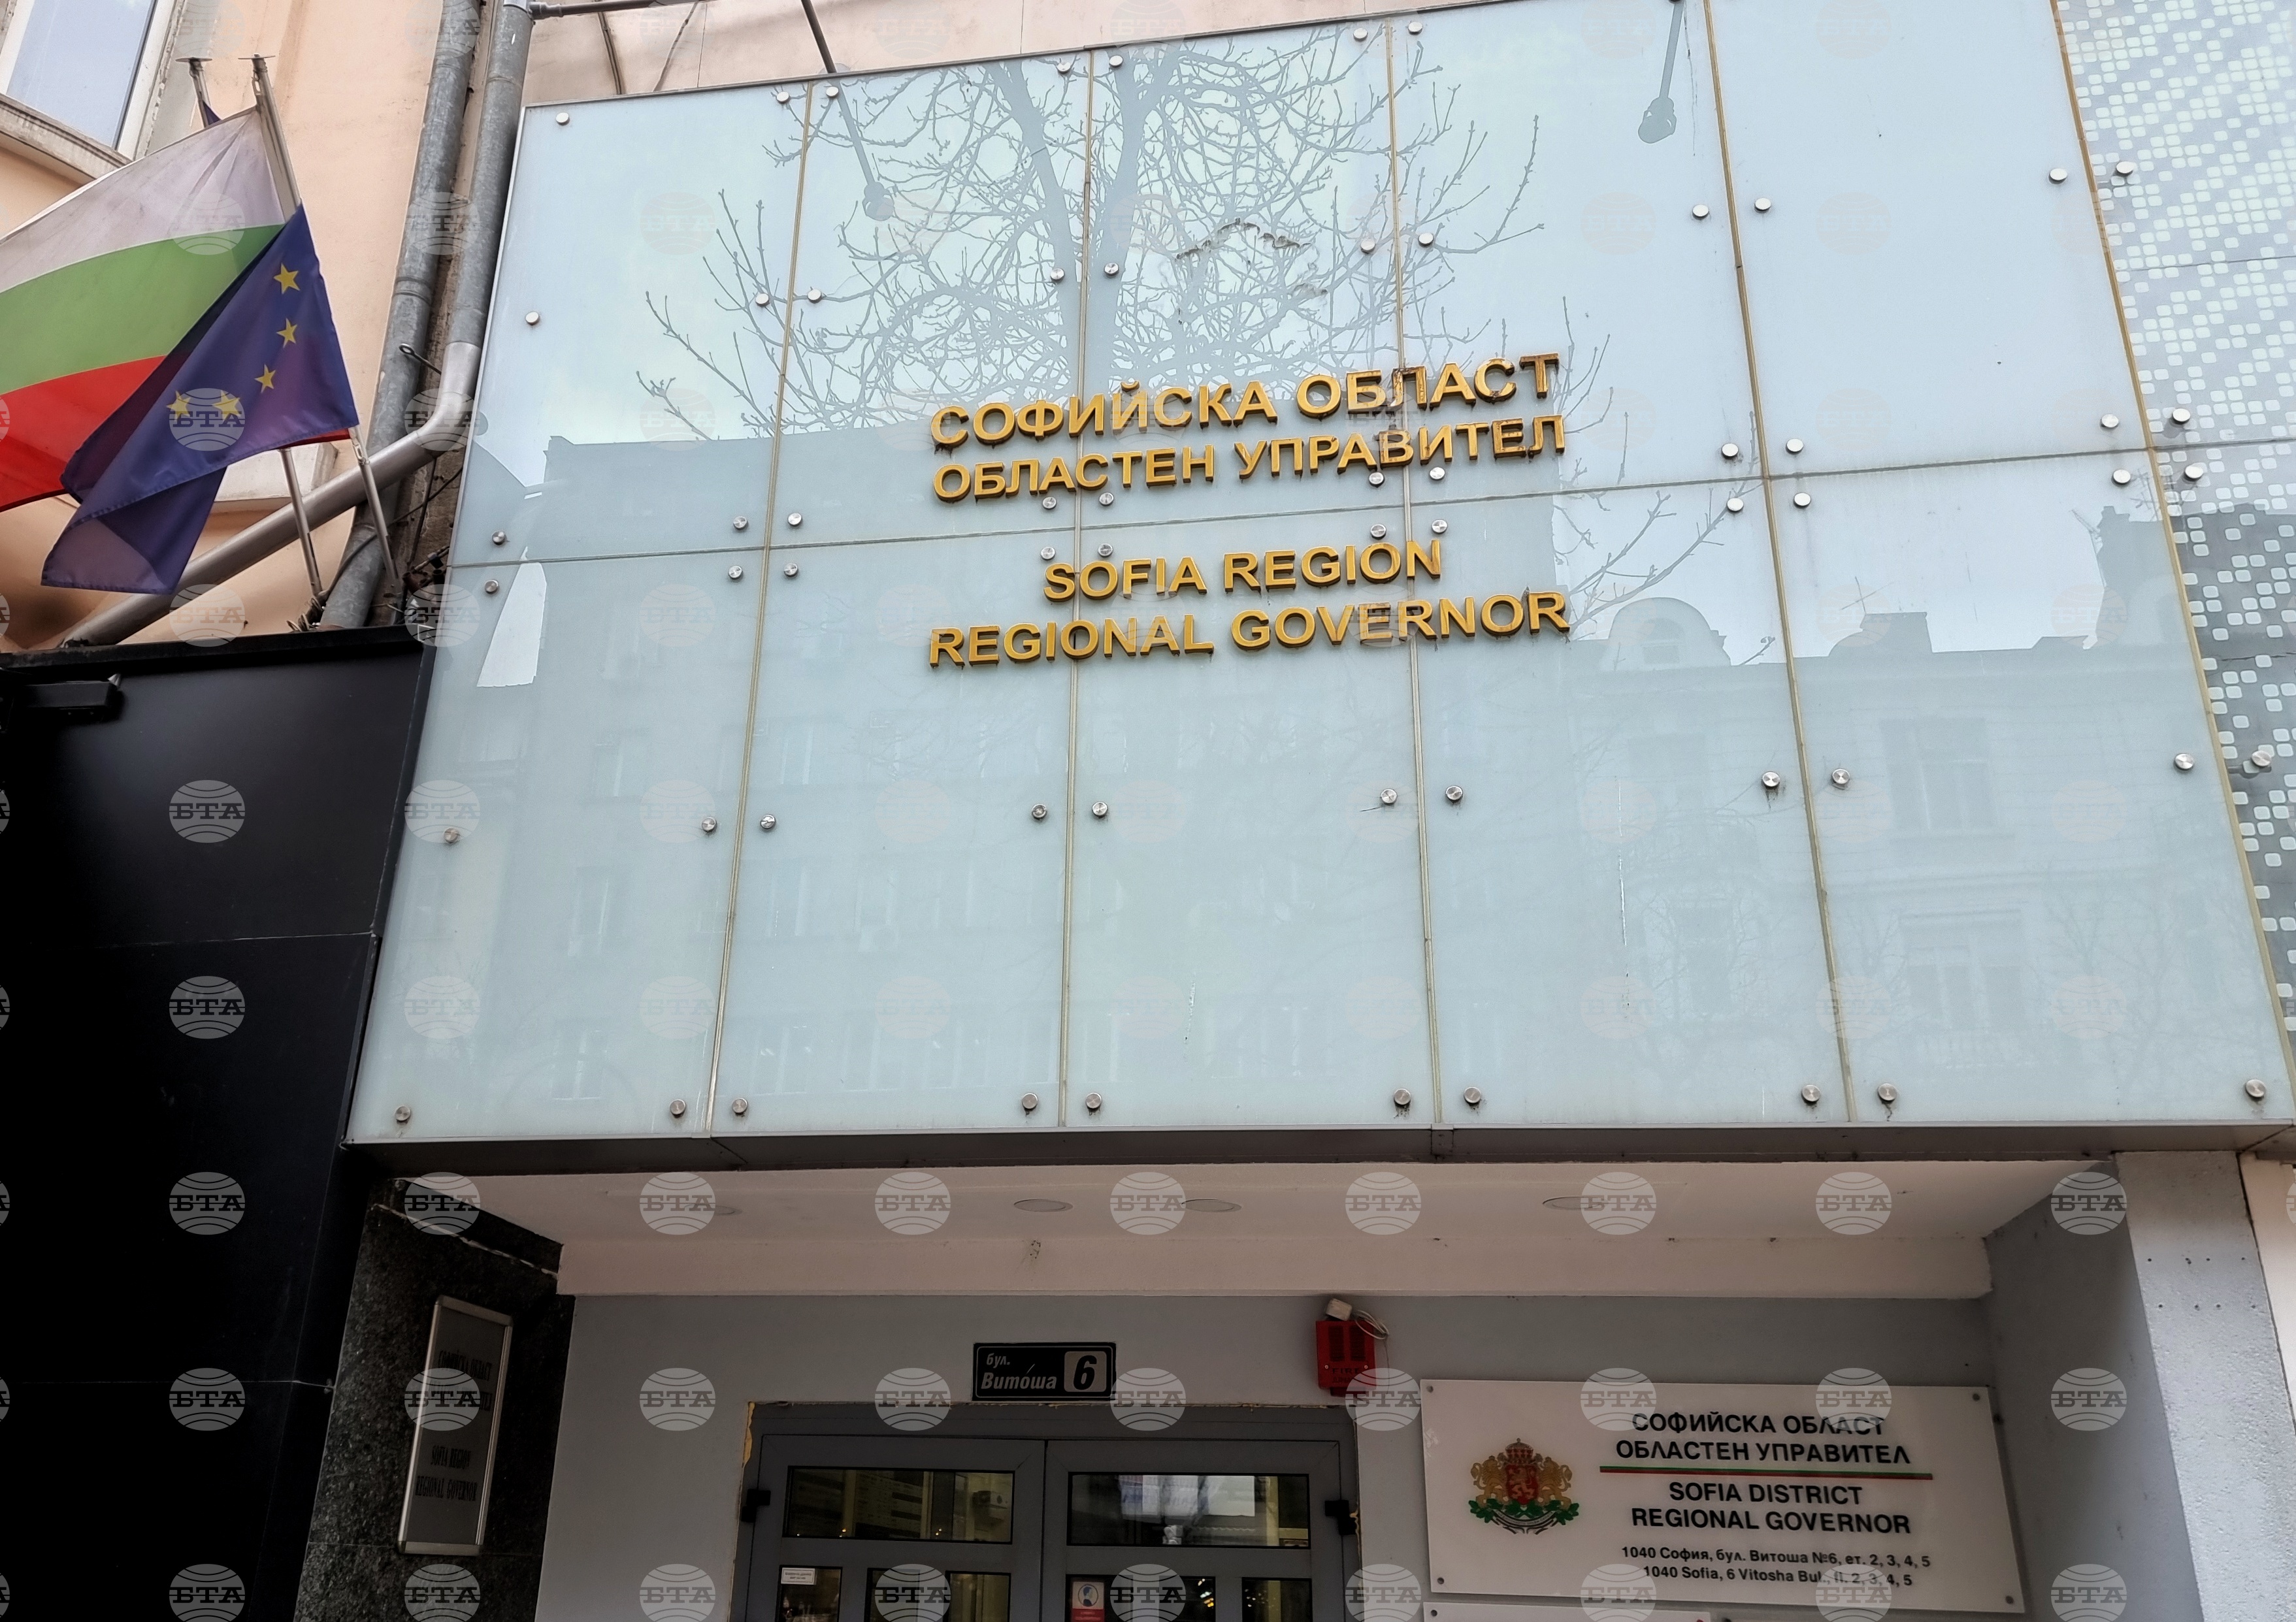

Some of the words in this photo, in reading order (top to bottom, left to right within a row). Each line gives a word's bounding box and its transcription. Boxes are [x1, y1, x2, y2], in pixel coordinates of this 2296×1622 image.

[931, 381, 1277, 448] СОФИЙСКА
[1297, 353, 1559, 419] ОБЛАСТ
[933, 444, 1215, 502] ОБЛАСТЕН
[1234, 415, 1565, 479] УПРАВИТЕЛ
[1043, 557, 1207, 602] SOFIA
[1224, 540, 1441, 592] REGION
[929, 615, 1215, 667] REGIONAL
[1231, 592, 1570, 650] GOVERNOR
[986, 1353, 1011, 1369] бул.
[1073, 1355, 1097, 1390] 6
[1632, 1411, 1776, 1433] СОФИЙСКА
[1783, 1415, 1884, 1435] ОБЛАСТ
[1616, 1440, 1749, 1461] ОБЛАСТЕН
[1756, 1442, 1911, 1465] УПРАВИТЕЛ
[1669, 1482, 1742, 1502] SOFIA
[1748, 1484, 1862, 1505] DISTRICT
[1632, 1508, 1759, 1530] REGIONAL
[1765, 1512, 1911, 1534] GOVERNOR
[1622, 1546, 1656, 1559] 1040
[1660, 1547, 1713, 1562] София,
[1716, 1549, 1746, 1563] бул.
[1749, 1549, 1809, 1563] Витоша
[1845, 1555, 1866, 1565] ет.
[1869, 1554, 1884, 1567] 2,
[1886, 1554, 1901, 1568] 3,
[1904, 1555, 1918, 1568] 4,
[1921, 1555, 1931, 1567] 5
[1643, 1566, 1678, 1578] 1040
[1682, 1566, 1724, 1581] Sofia,
[1726, 1568, 1735, 1580] 6
[1738, 1568, 1794, 1581] Vitosha
[1886, 1574, 1900, 1587] 4,
[1903, 1574, 1913, 1586] 5
